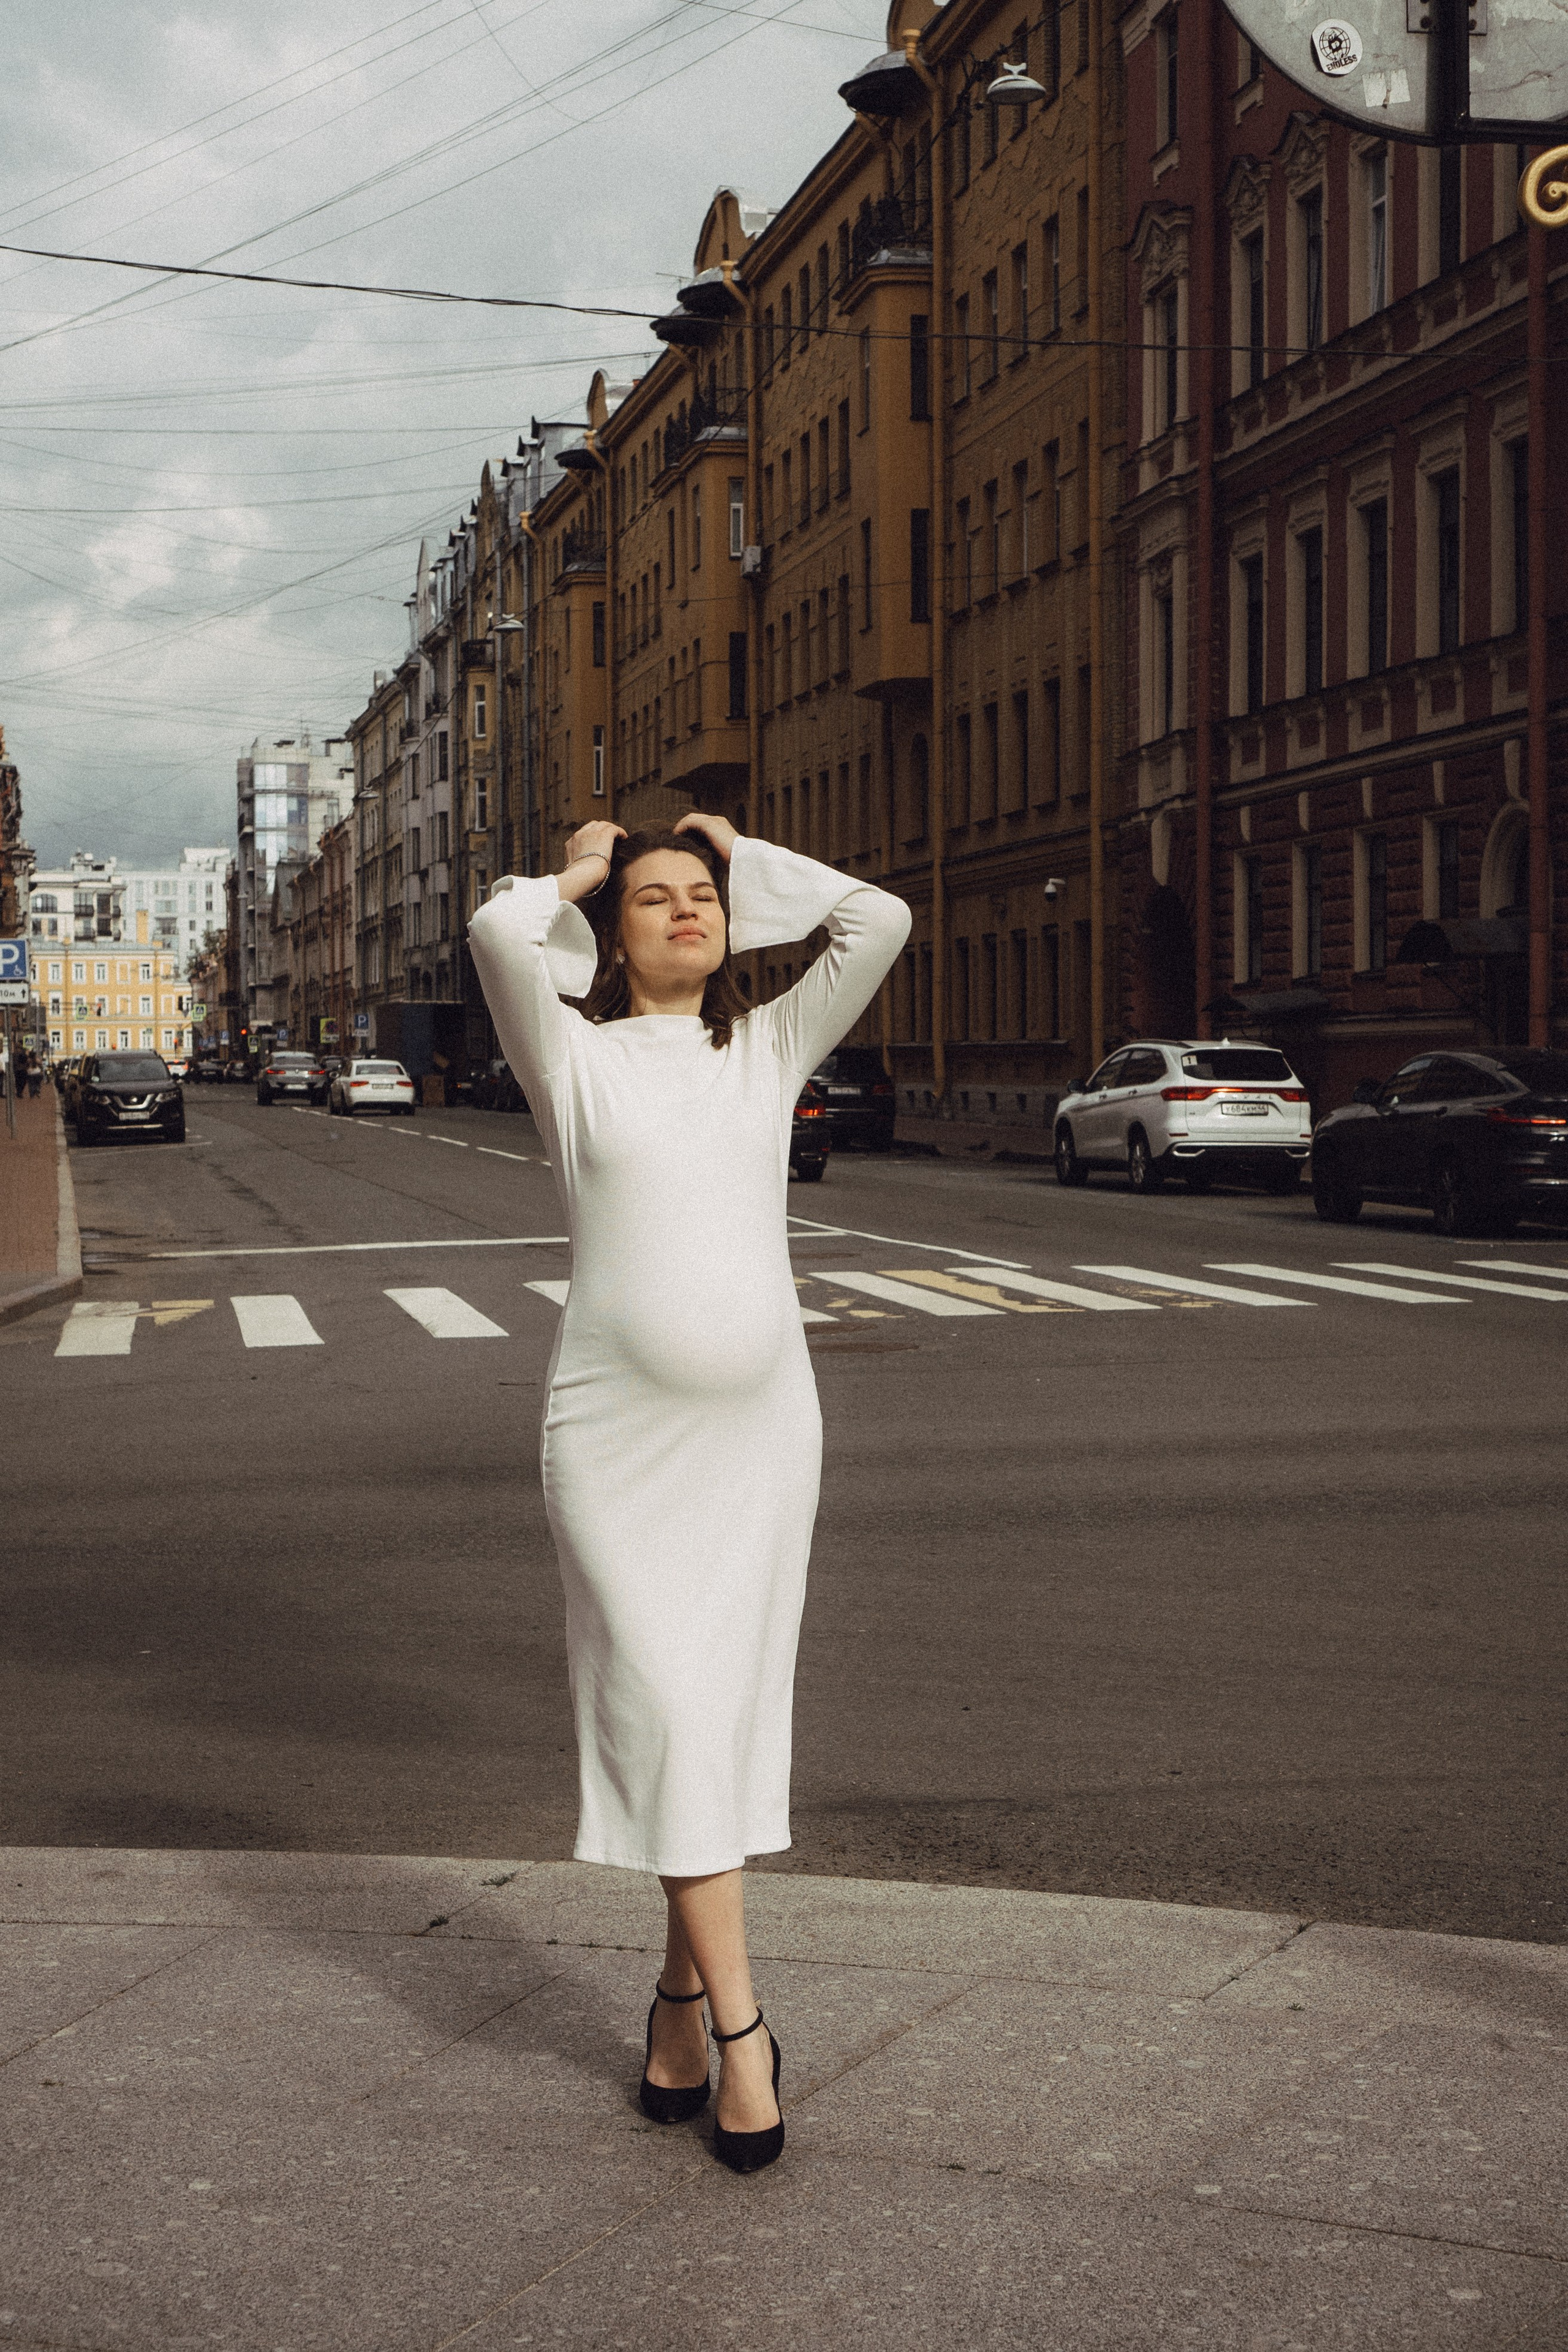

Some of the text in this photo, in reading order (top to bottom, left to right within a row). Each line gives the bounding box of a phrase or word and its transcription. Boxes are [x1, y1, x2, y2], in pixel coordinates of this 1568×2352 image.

[1326, 54, 1358, 71] ENDLESS
[0, 943, 20, 976] P
[358, 1015, 366, 1028] P
